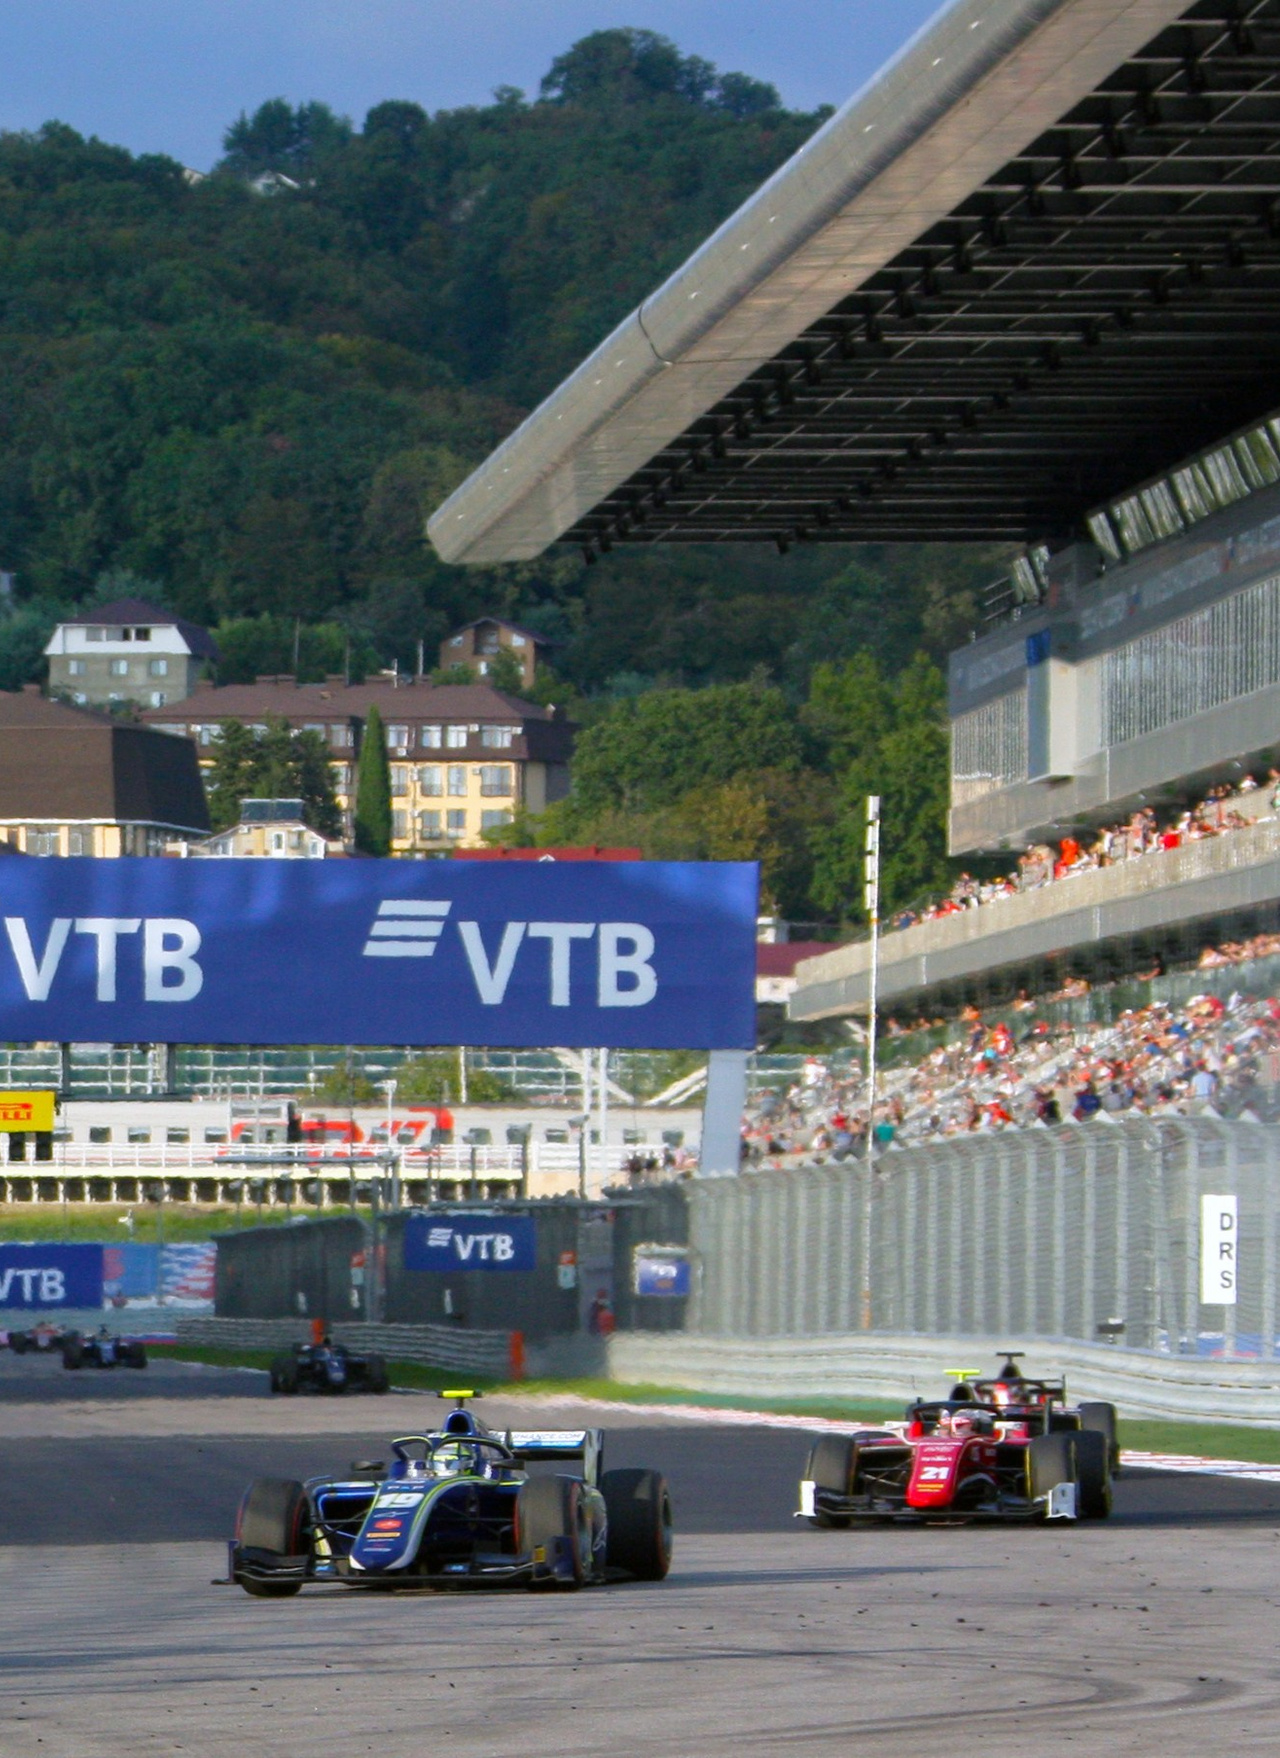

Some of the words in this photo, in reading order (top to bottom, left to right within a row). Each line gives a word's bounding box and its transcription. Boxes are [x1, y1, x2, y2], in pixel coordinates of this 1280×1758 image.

[4, 917, 204, 1002] VTB
[457, 921, 658, 1008] VTB
[453, 1233, 515, 1262] VTB
[919, 1466, 950, 1480] 21
[374, 1492, 425, 1509] 19
